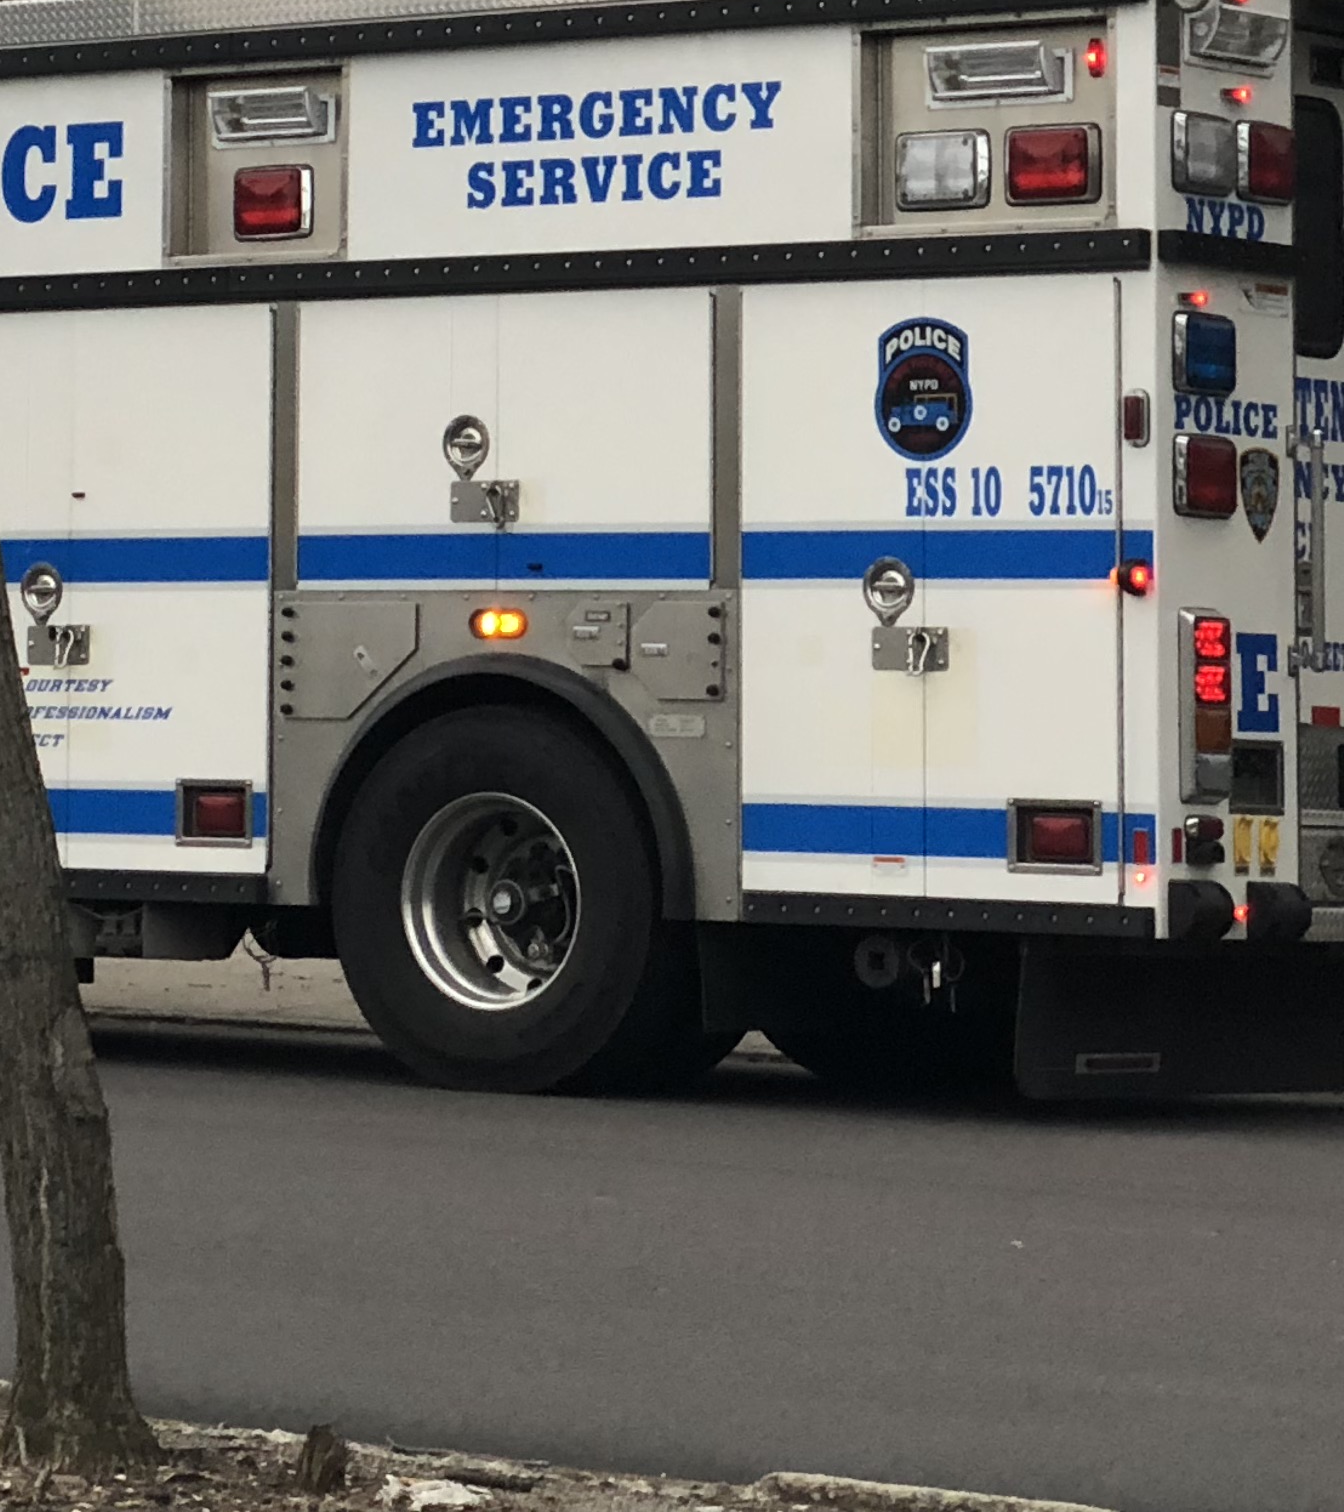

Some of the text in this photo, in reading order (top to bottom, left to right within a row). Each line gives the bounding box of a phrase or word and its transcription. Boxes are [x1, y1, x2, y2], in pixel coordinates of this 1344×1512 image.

[412, 81, 782, 148] EMERGENCY
[467, 150, 722, 209] SERVICE
[1185, 197, 1266, 241] NYPD
[885, 326, 961, 364] POLICE
[909, 378, 939, 391] NYPD
[1174, 394, 1278, 439] POLICE
[905, 467, 957, 516] ESS
[971, 465, 1002, 516] 10
[24, 679, 113, 693] OURTESY
[1235, 632, 1280, 733] E
